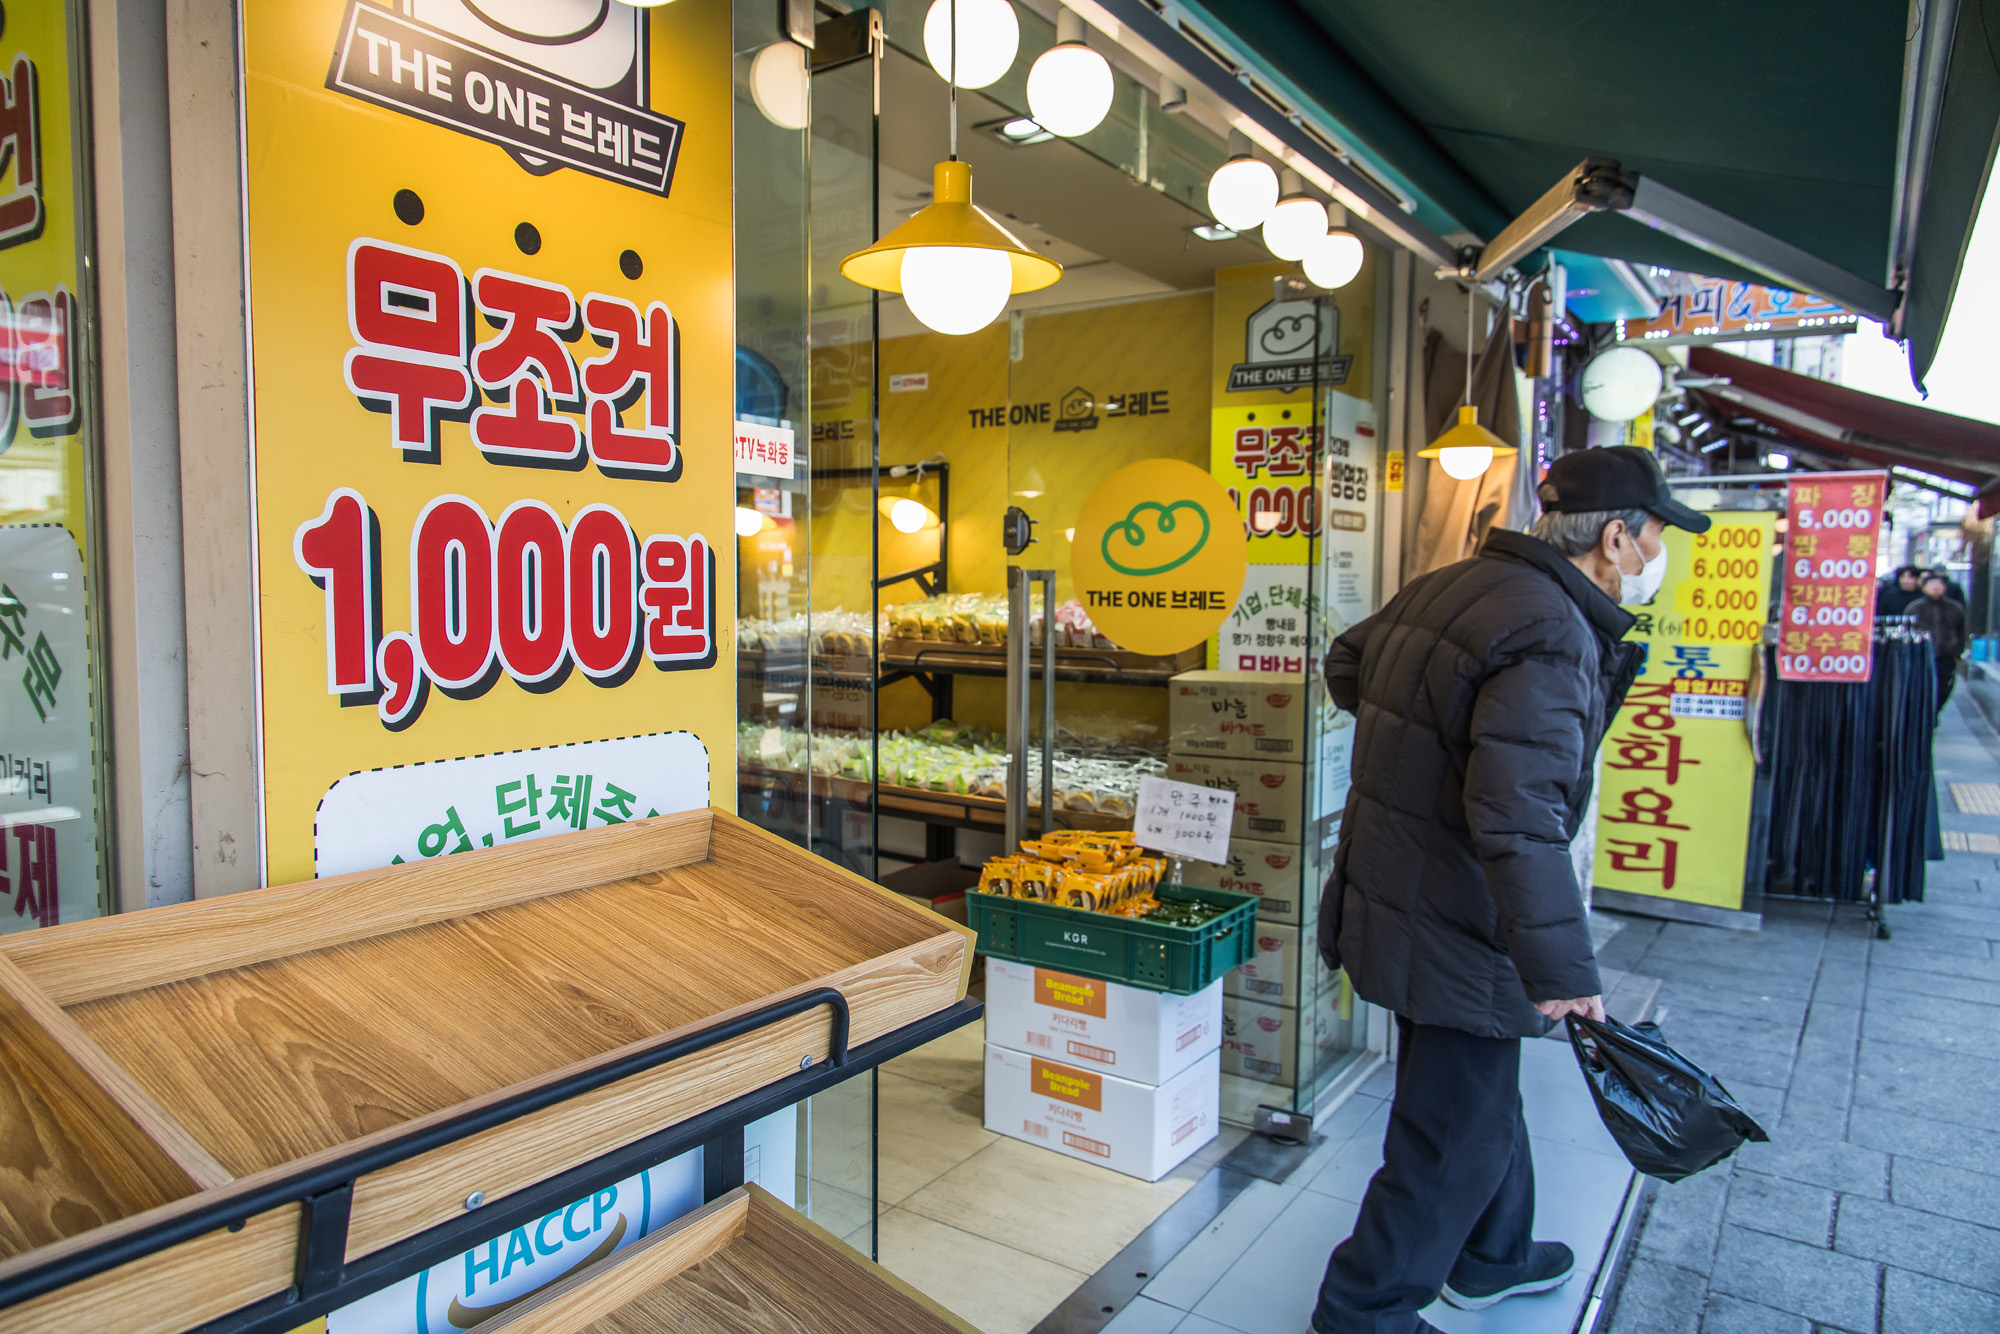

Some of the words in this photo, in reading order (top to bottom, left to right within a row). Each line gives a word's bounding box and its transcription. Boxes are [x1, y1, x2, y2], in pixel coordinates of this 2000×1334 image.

[357, 26, 454, 102] THE
[463, 69, 550, 137] ONE
[560, 105, 664, 176] 브레드
[344, 236, 684, 483] 무조건
[1236, 370, 1263, 384] THE
[1265, 367, 1296, 382] ONE
[968, 407, 1006, 428] THE
[1009, 402, 1050, 425] ONE
[1107, 390, 1170, 417] 브레드
[1797, 509, 1872, 531] 5,000
[1695, 528, 1762, 549] 5,000
[1693, 558, 1759, 580] 6,000
[1794, 559, 1869, 580] 6,000
[1086, 590, 1123, 607] THE
[1127, 590, 1167, 608] ONE
[1170, 590, 1227, 611] 브레드
[1691, 588, 1758, 611] 6,000
[1790, 584, 1869, 608] 간짜장
[293, 486, 717, 732] 1,000원
[1791, 606, 1864, 627] 6,000
[1683, 618, 1761, 641] 10,000
[1781, 654, 1867, 675] 10,000
[1211, 697, 1248, 719] 마늘
[1063, 931, 1089, 945] KGR
[1045, 978, 1095, 998] Beanpole
[1053, 990, 1085, 1006] Bread
[1042, 1068, 1091, 1091] Beanpole
[1049, 1081, 1080, 1098] Bread
[464, 1184, 618, 1298] HACCP
